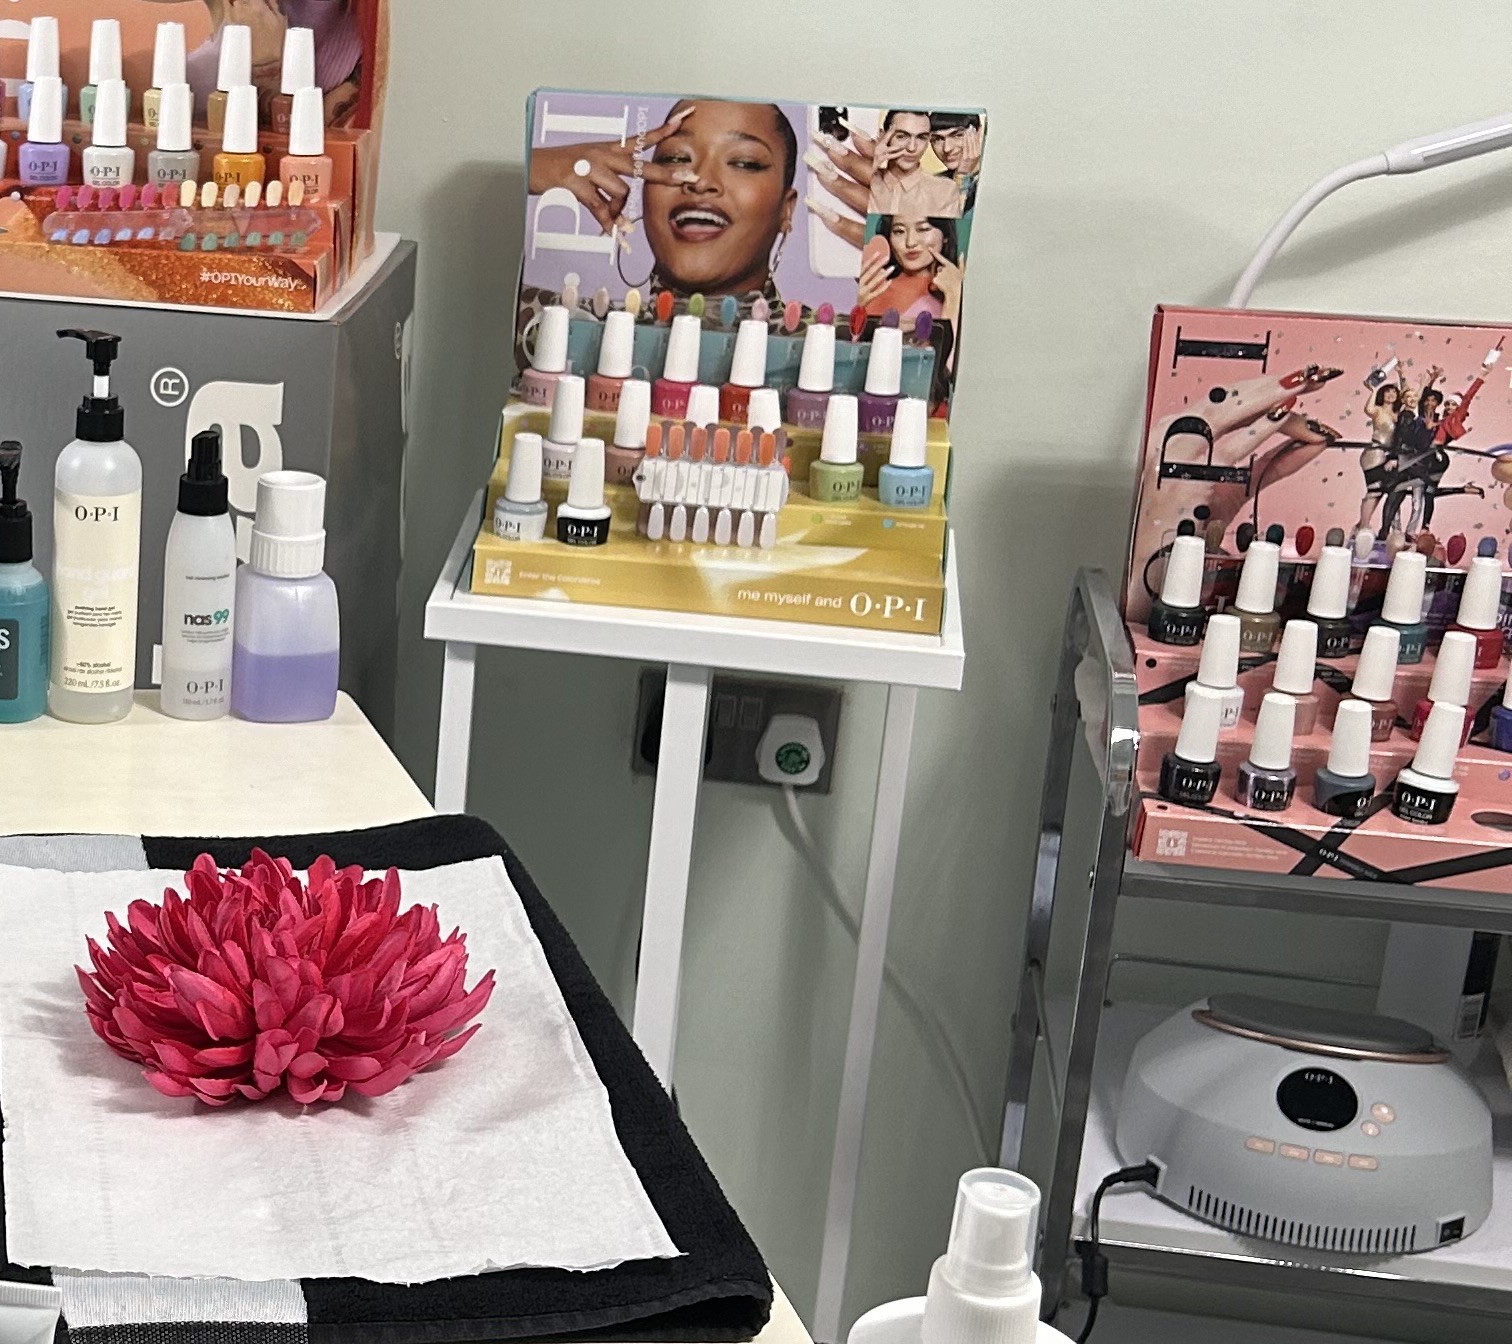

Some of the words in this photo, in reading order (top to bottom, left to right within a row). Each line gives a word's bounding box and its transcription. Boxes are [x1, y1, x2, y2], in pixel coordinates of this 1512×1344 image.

[737, 589, 761, 601] me
[764, 591, 812, 606] myself
[814, 595, 843, 609] and
